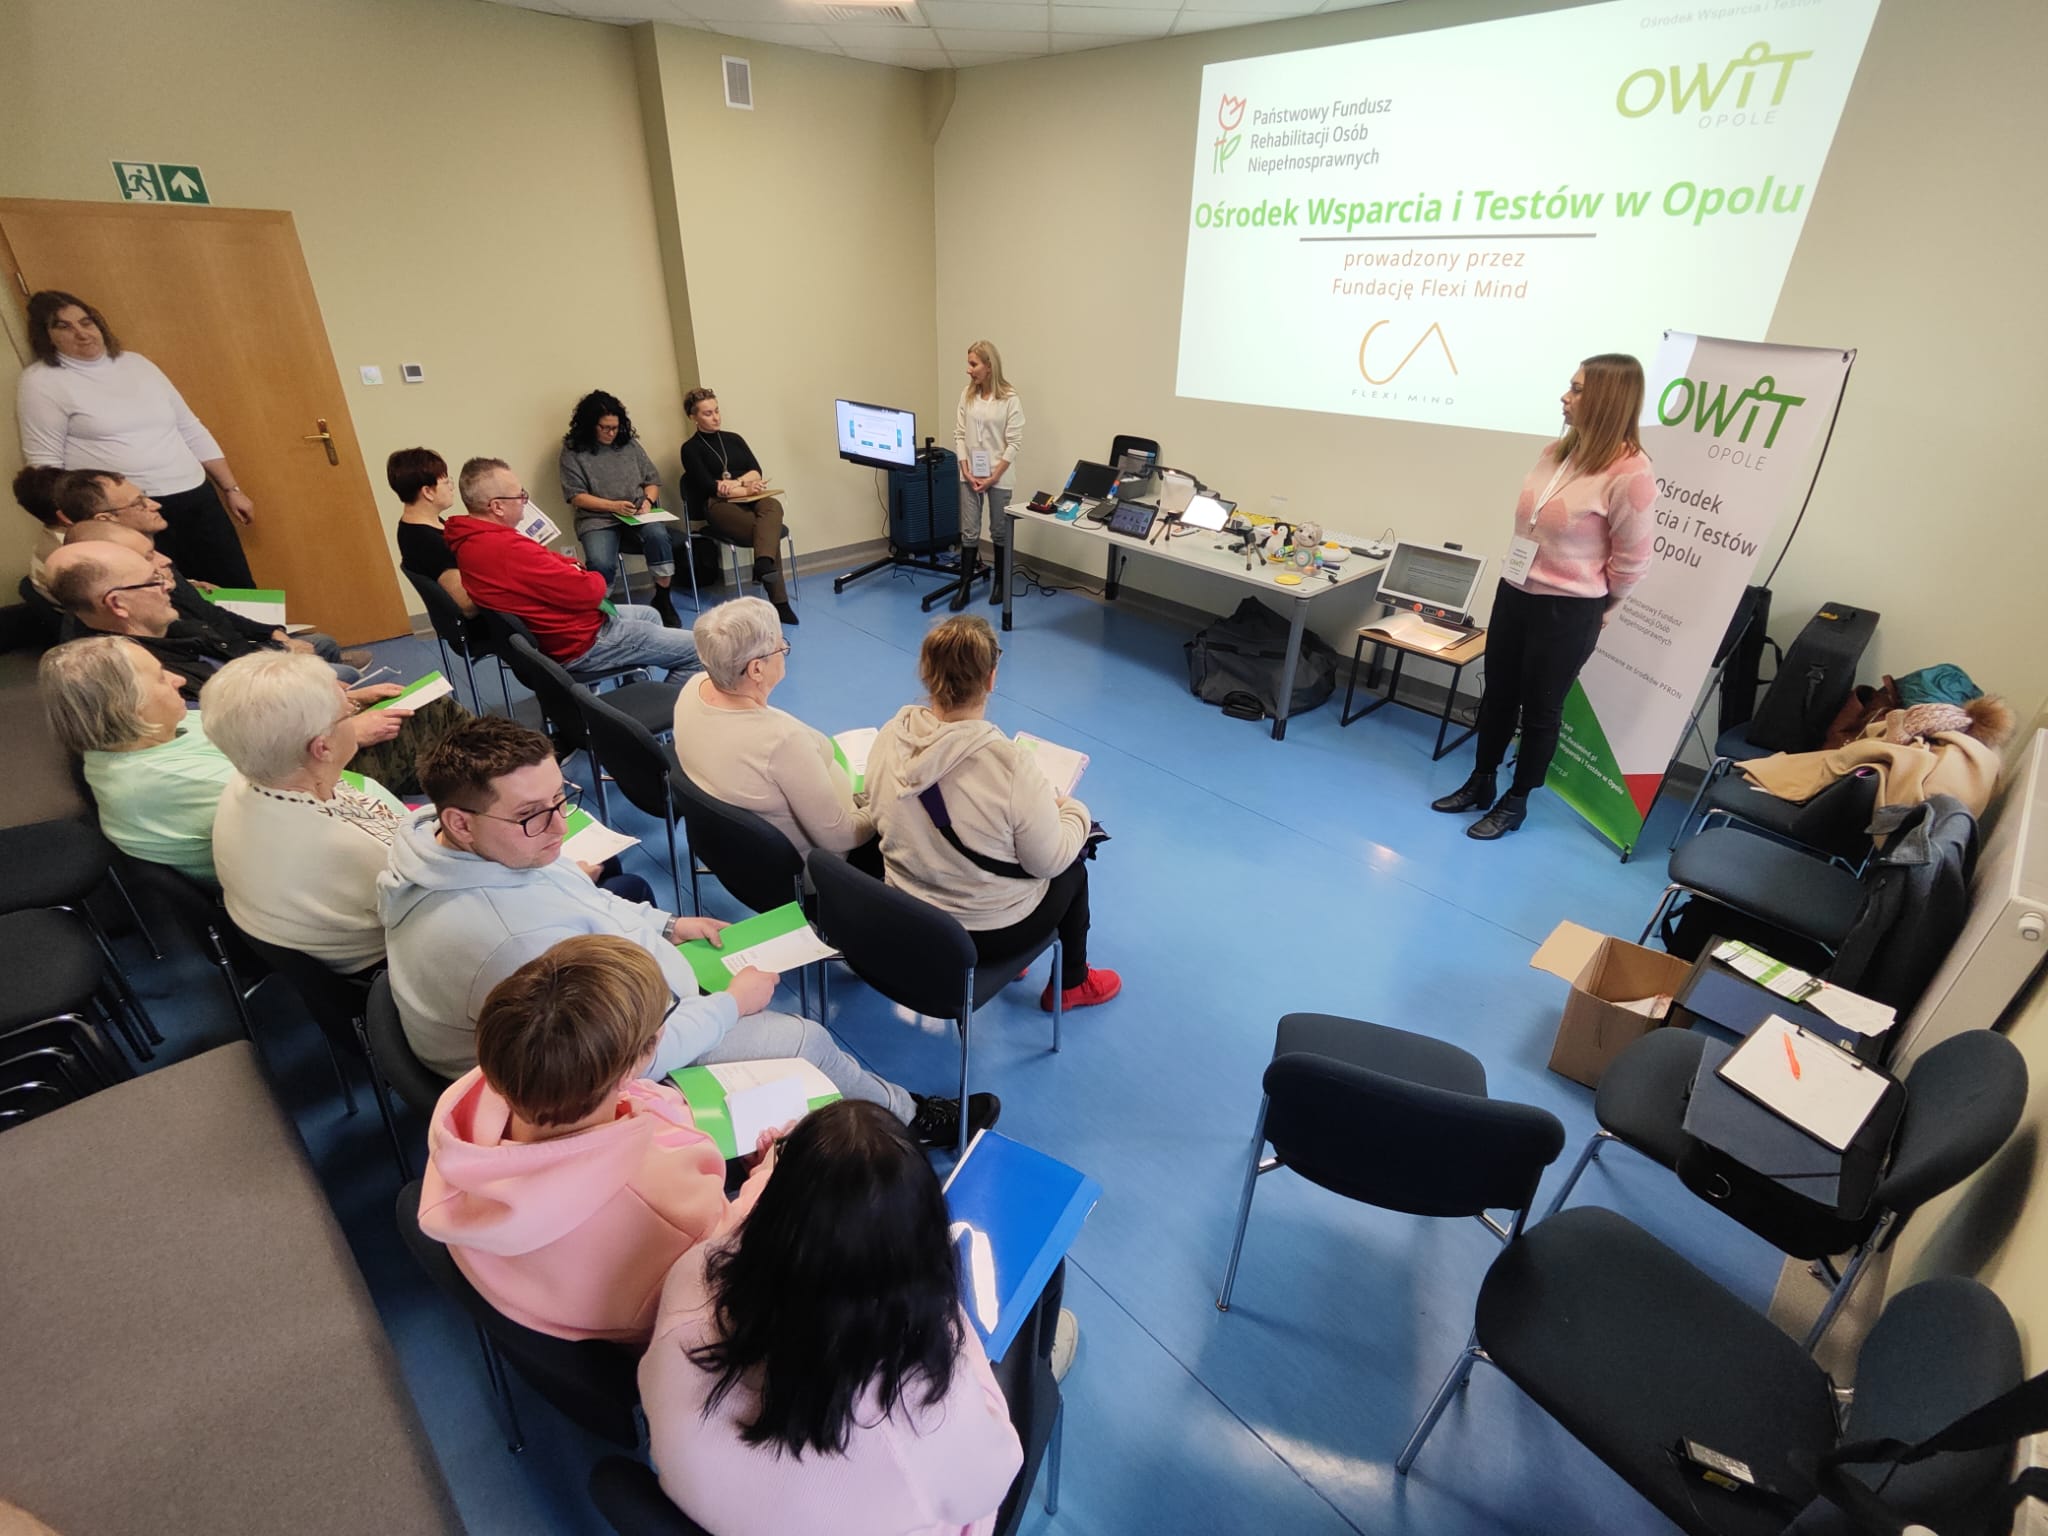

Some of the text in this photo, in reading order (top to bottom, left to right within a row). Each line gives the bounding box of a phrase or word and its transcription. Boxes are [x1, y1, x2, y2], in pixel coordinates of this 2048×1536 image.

[1252, 97, 1393, 126] Państwowy Fundusz
[1698, 110, 1778, 129] OPOLE
[1250, 123, 1369, 149] Rehabilitacji Osób
[1248, 147, 1380, 175] Niepełnosprawnych
[1195, 175, 1806, 233] Ośrodek Wsparcia i Testów w Opolu
[1343, 249, 1526, 272] prowadzony przez
[1332, 278, 1529, 301] Fundację Flexi Mind
[1351, 388, 1455, 406] FLEXI MIND
[1707, 444, 1768, 471] OPOLE
[1682, 516, 1692, 533] i
[1694, 519, 1758, 558] Testów
[1653, 535, 1702, 568] Opolu
[1659, 681, 1683, 700] PFRON
